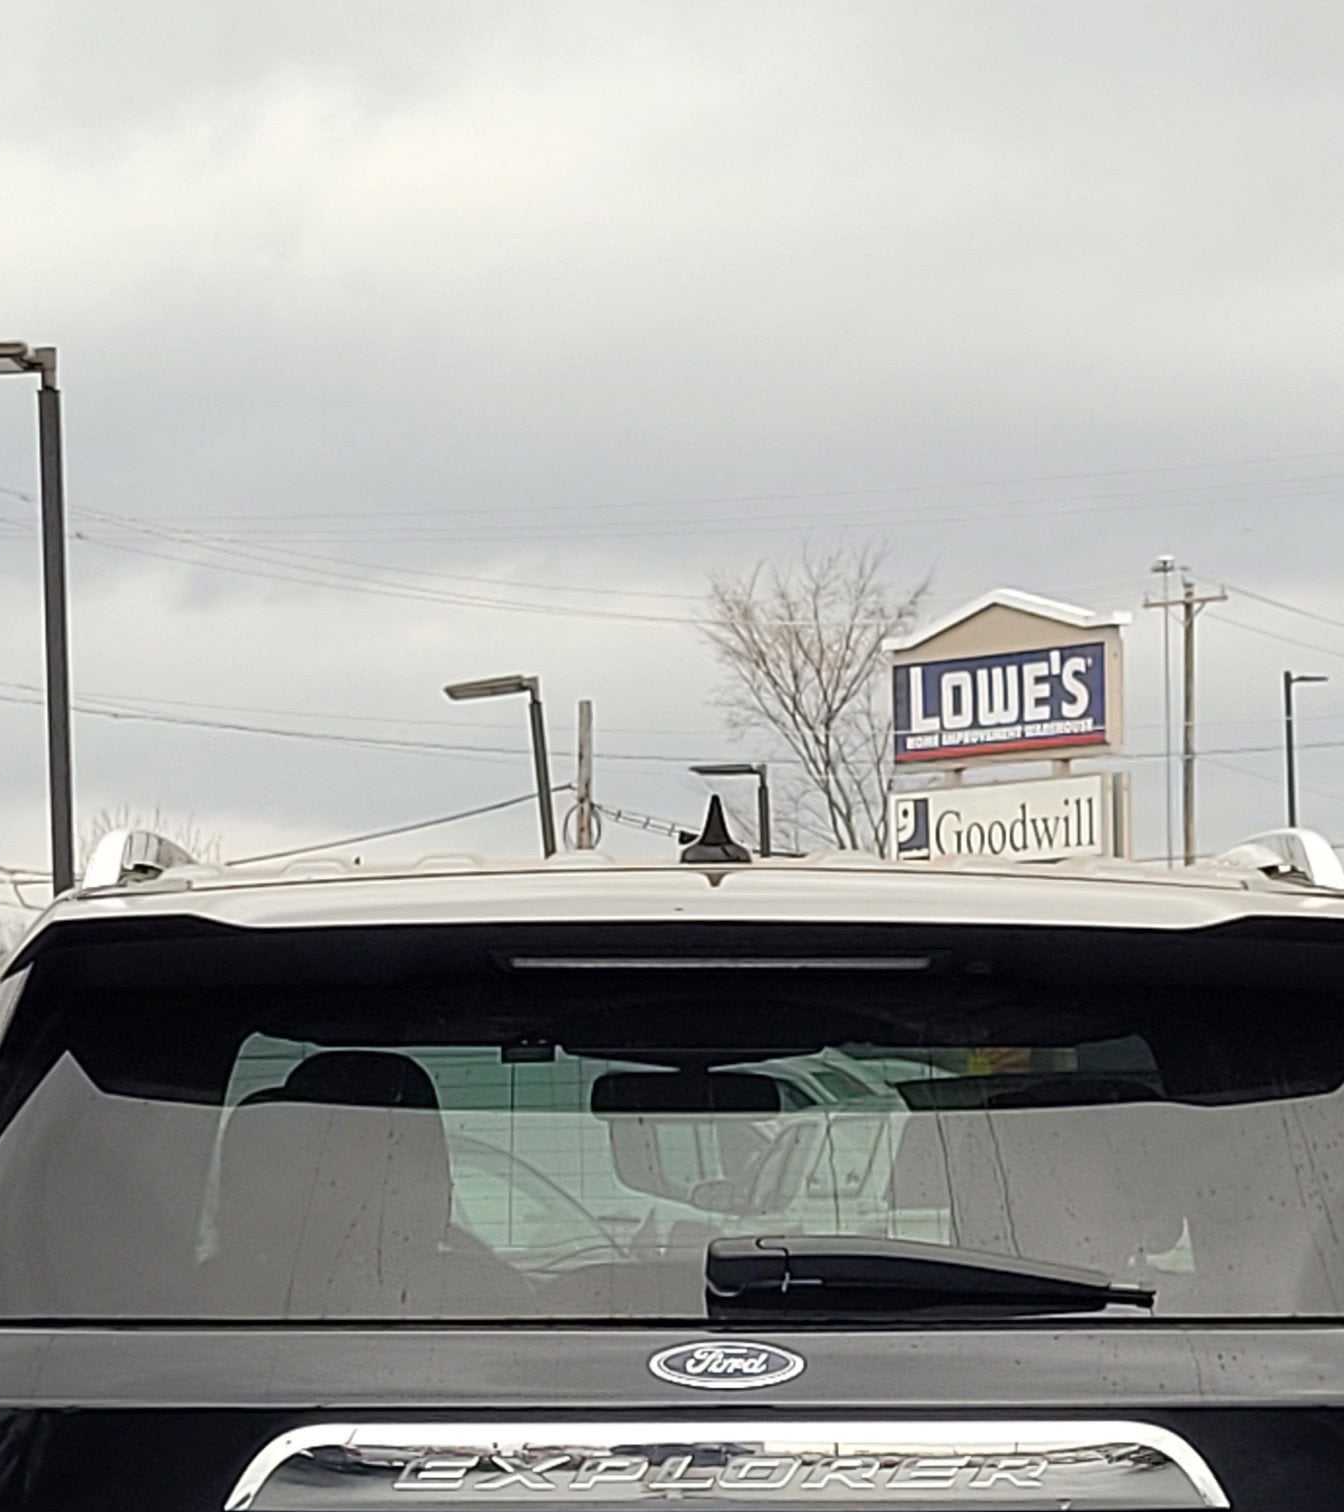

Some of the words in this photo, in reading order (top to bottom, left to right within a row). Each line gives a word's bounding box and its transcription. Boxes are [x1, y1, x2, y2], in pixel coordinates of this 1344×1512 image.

[908, 649, 1089, 733] LOWE'S
[935, 797, 1095, 856] Goodwill
[685, 1347, 769, 1375] Ford
[392, 1453, 1050, 1492] EXPLORER
